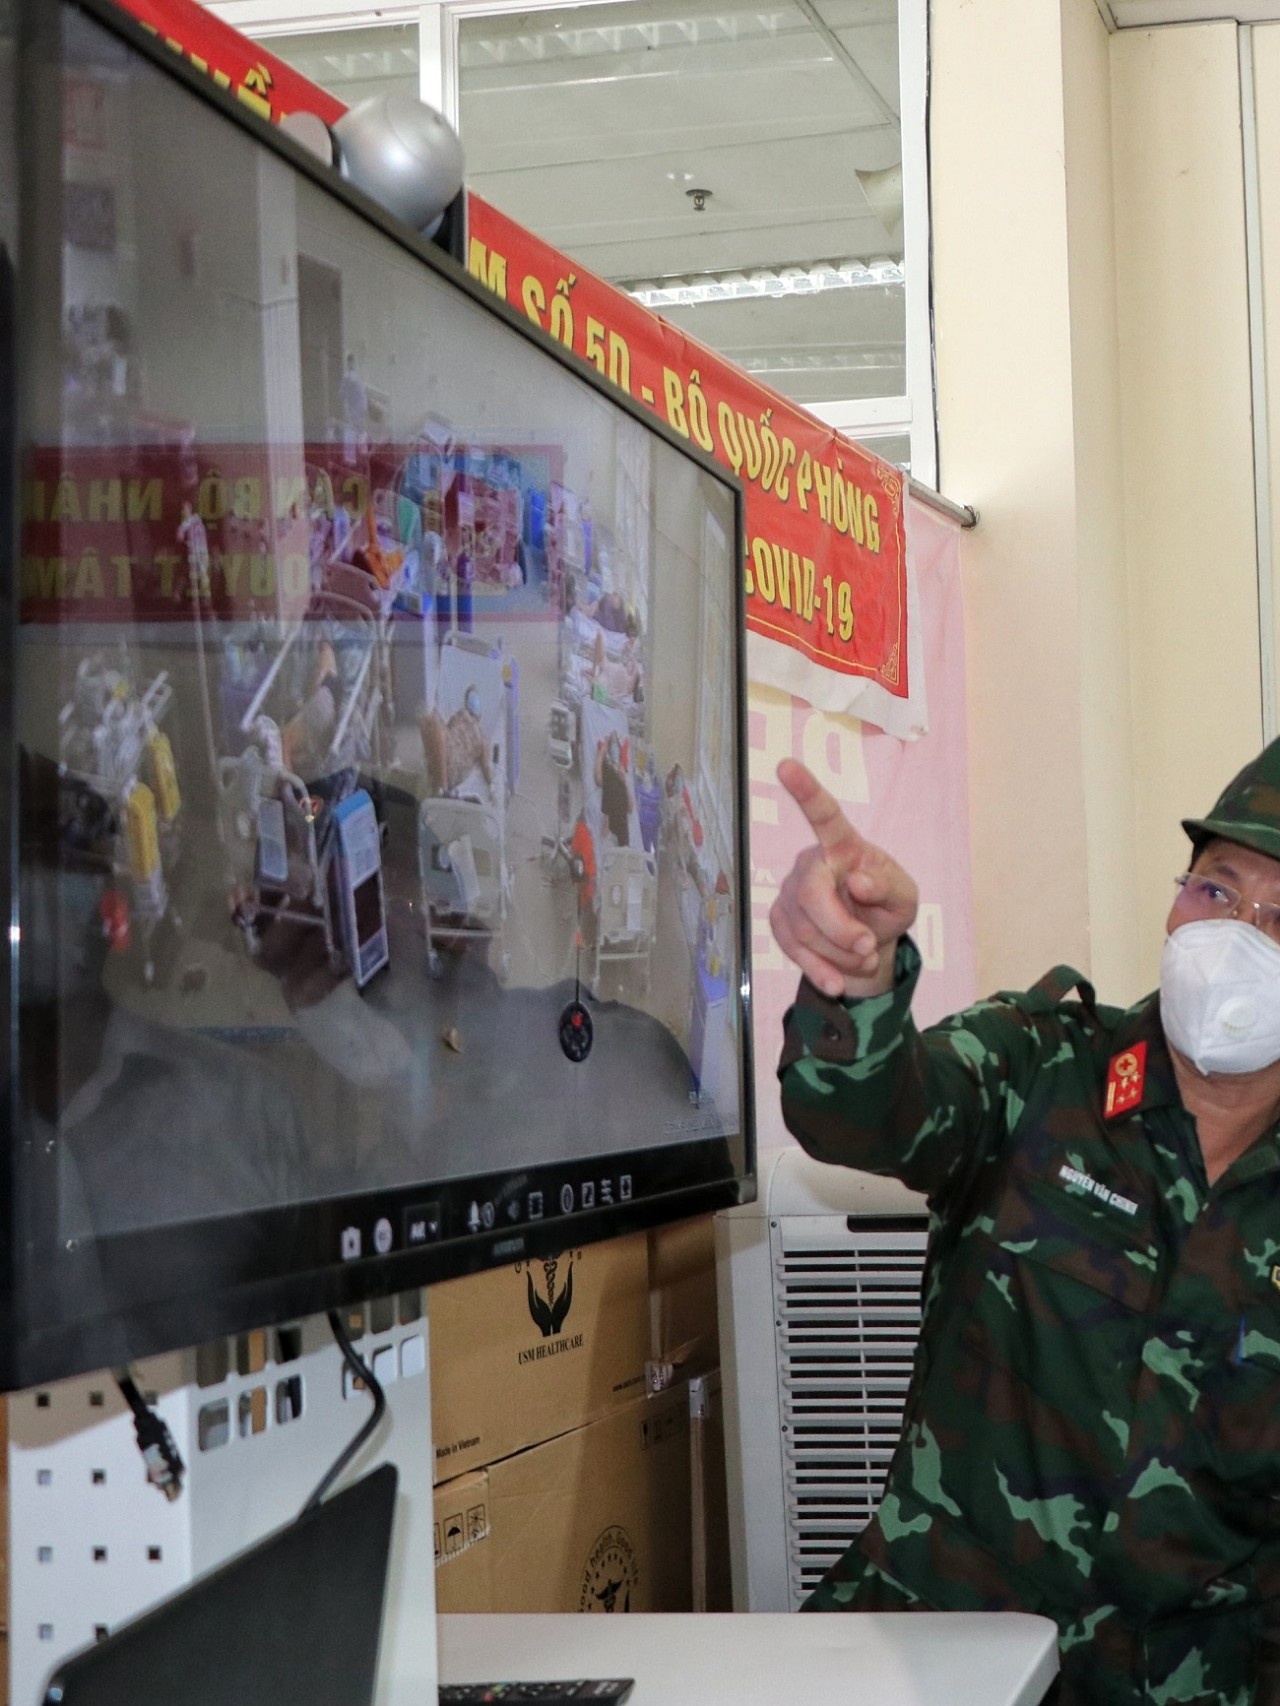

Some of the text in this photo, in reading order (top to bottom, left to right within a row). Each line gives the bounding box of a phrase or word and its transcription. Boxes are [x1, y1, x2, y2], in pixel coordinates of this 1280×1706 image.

[718, 401, 797, 502] QUỐC
[797, 449, 880, 554] PHÒNG
[535, 1333, 584, 1360] HEALTHCARE
